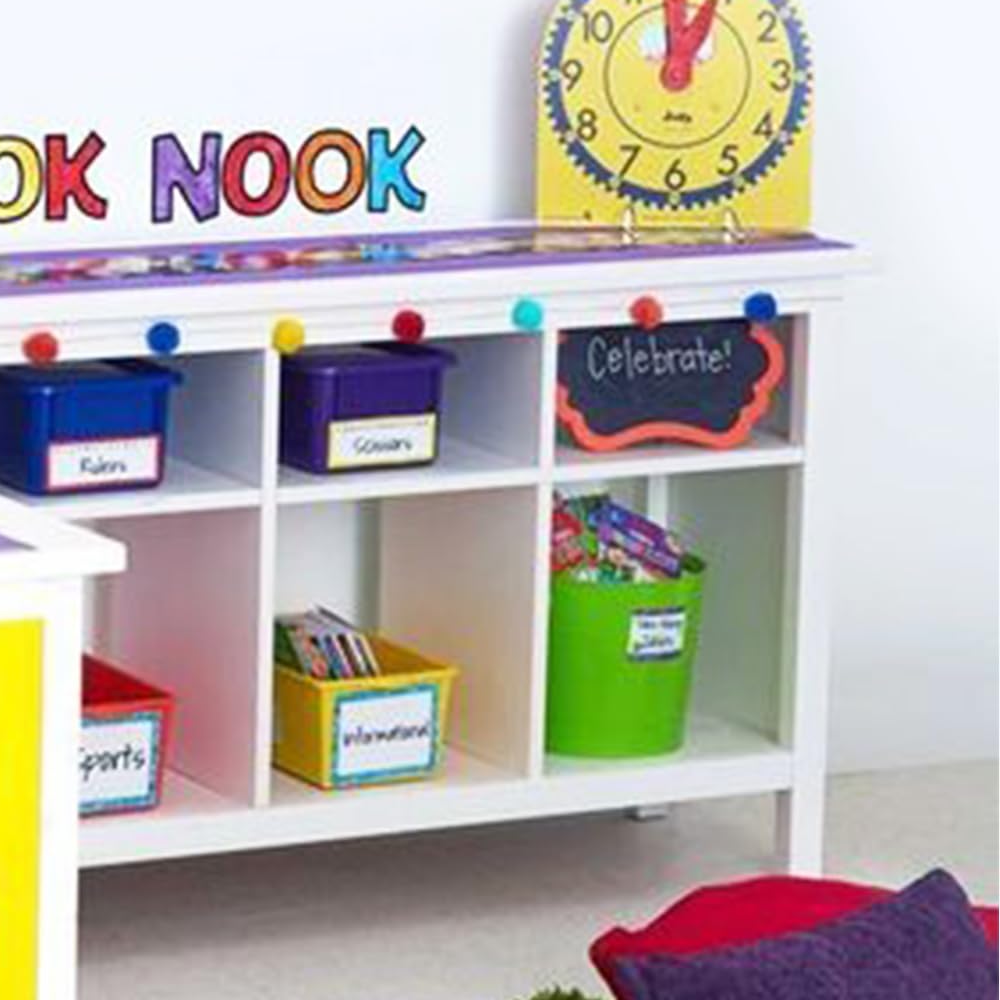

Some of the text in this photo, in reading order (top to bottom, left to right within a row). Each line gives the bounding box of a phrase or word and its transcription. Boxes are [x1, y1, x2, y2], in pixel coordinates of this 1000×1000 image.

[581, 10, 614, 43] 10
[758, 11, 778, 42] 2
[561, 59, 583, 91] 9
[770, 60, 791, 92] 3
[576, 109, 597, 141] 8
[753, 112, 773, 140] 4
[152, 125, 427, 224] NOOK
[620, 145, 641, 177] 7
[664, 159, 686, 190] 6
[717, 145, 739, 176] 5
[587, 335, 732, 380] Celebrate!
